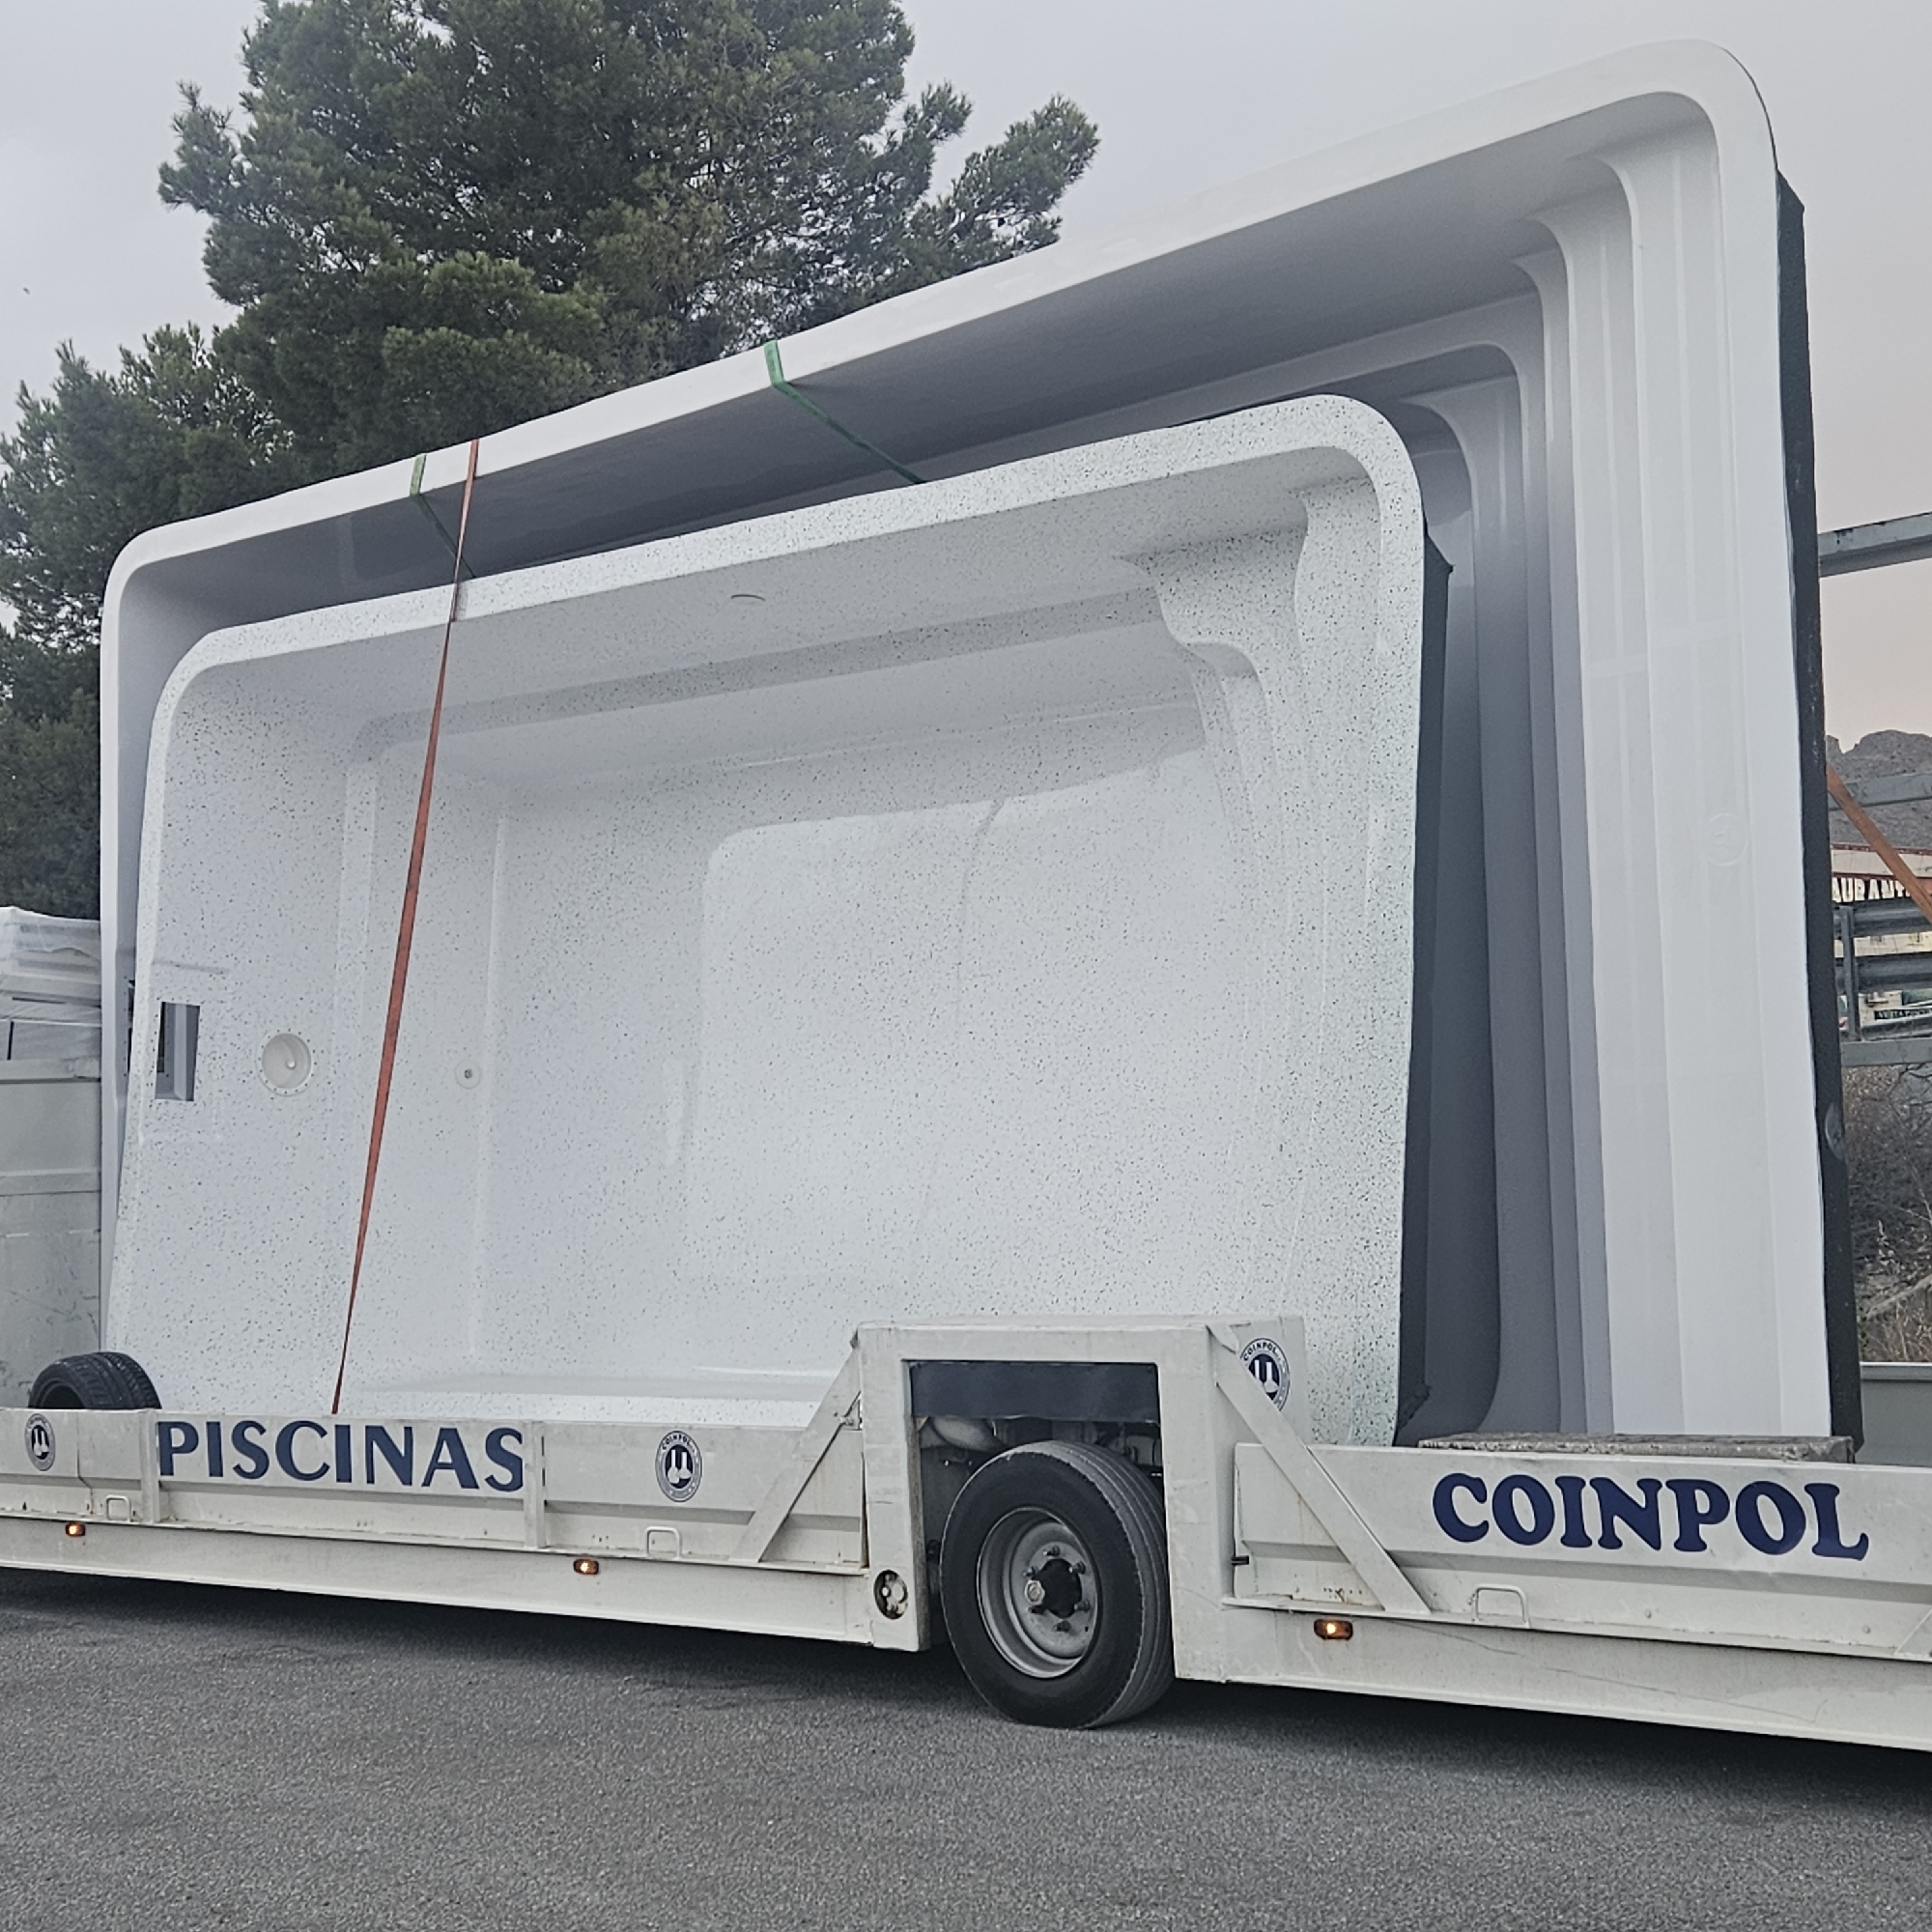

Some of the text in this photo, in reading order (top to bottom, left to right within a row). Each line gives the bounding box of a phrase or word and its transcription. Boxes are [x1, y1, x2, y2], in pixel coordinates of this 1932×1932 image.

[1243, 1342, 1277, 1361] COINPOL
[156, 1419, 523, 1492] PISCINAS
[1433, 1472, 1869, 1561] COINPOL
